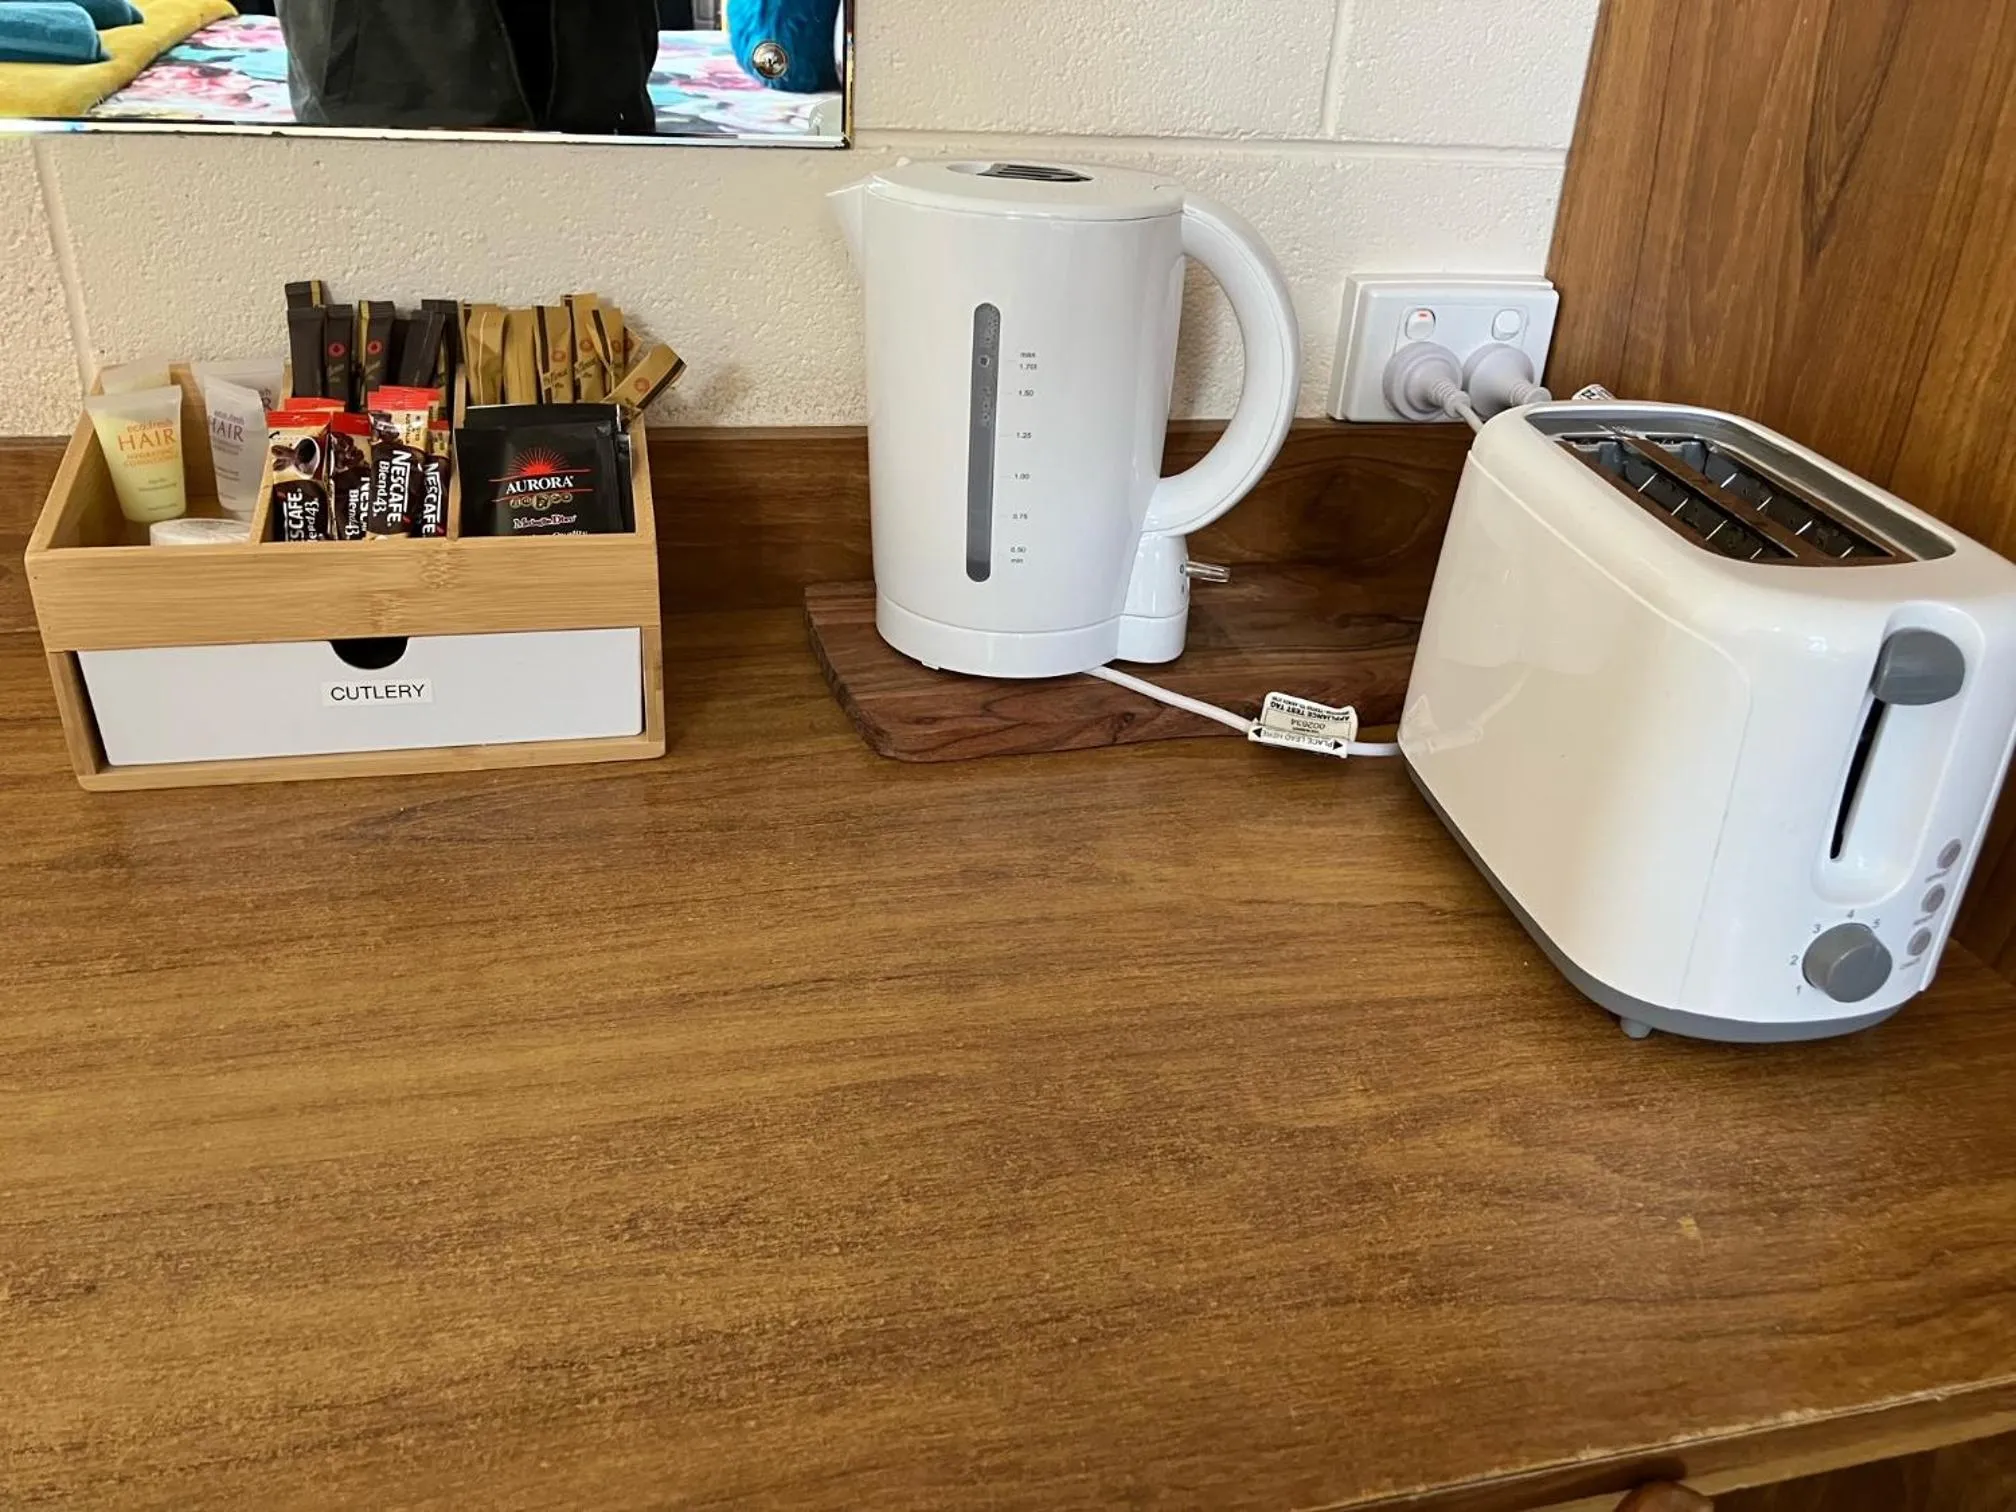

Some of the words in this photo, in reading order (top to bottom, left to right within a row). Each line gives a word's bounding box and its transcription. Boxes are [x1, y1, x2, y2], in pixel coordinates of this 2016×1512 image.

[1018, 389, 1034, 397] 1.50
[118, 428, 176, 451] HAIR
[378, 460, 389, 498] Blend
[1014, 472, 1030, 480] 1.00
[506, 476, 574, 494] AURORA
[330, 684, 425, 701] CUTLERY
[1270, 701, 1285, 710] TAG
[1286, 707, 1305, 716] TEST
[1307, 712, 1350, 721] APPLIANCE
[1284, 734, 1305, 744] LEAD
[1308, 737, 1334, 748] PLACE
[1847, 909, 1855, 918] 4
[1873, 918, 1880, 928] 5
[1812, 924, 1821, 934] 3
[1790, 955, 1799, 966] 2
[1795, 985, 1801, 995] 1
